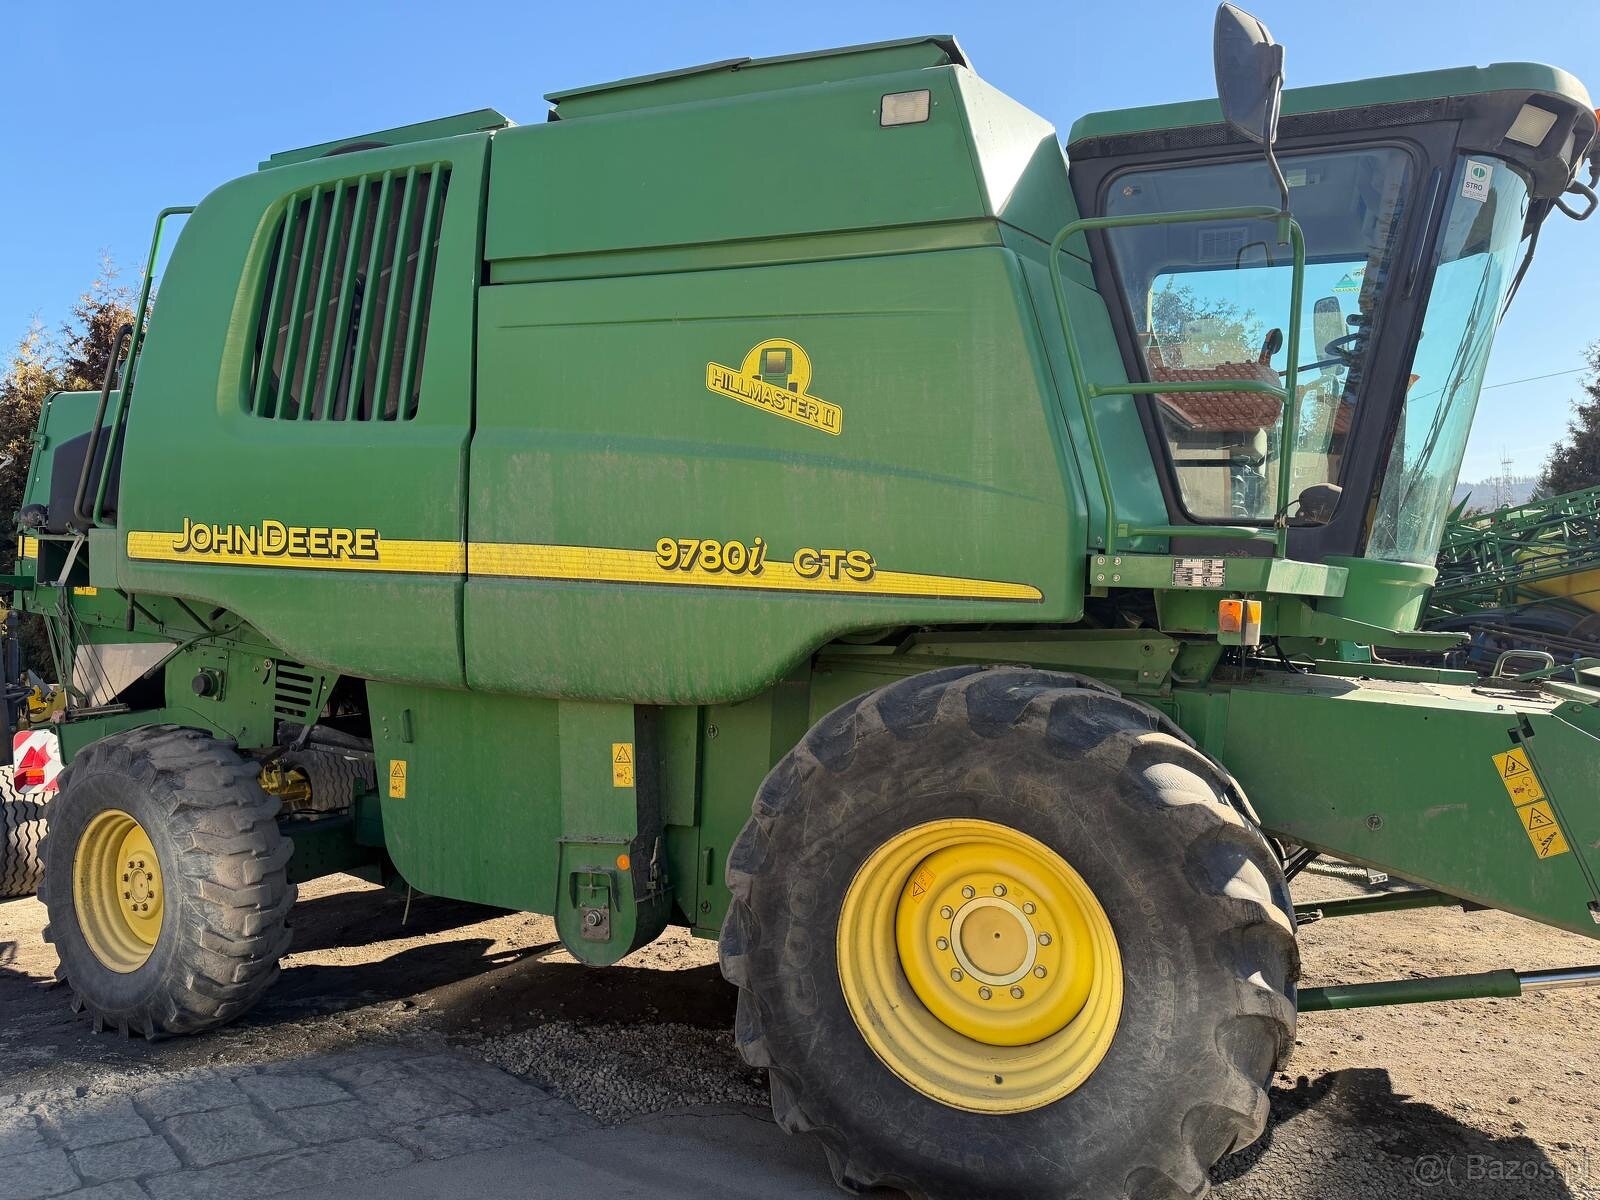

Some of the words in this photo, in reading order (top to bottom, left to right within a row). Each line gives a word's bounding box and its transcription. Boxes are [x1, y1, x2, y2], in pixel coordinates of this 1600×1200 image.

[712, 368, 819, 423] HILLMASTER
[822, 407, 836, 428] II
[173, 517, 258, 555] JOHN
[261, 519, 379, 560] DEERE
[655, 536, 767, 576] 9780i
[793, 547, 876, 582] CTS
